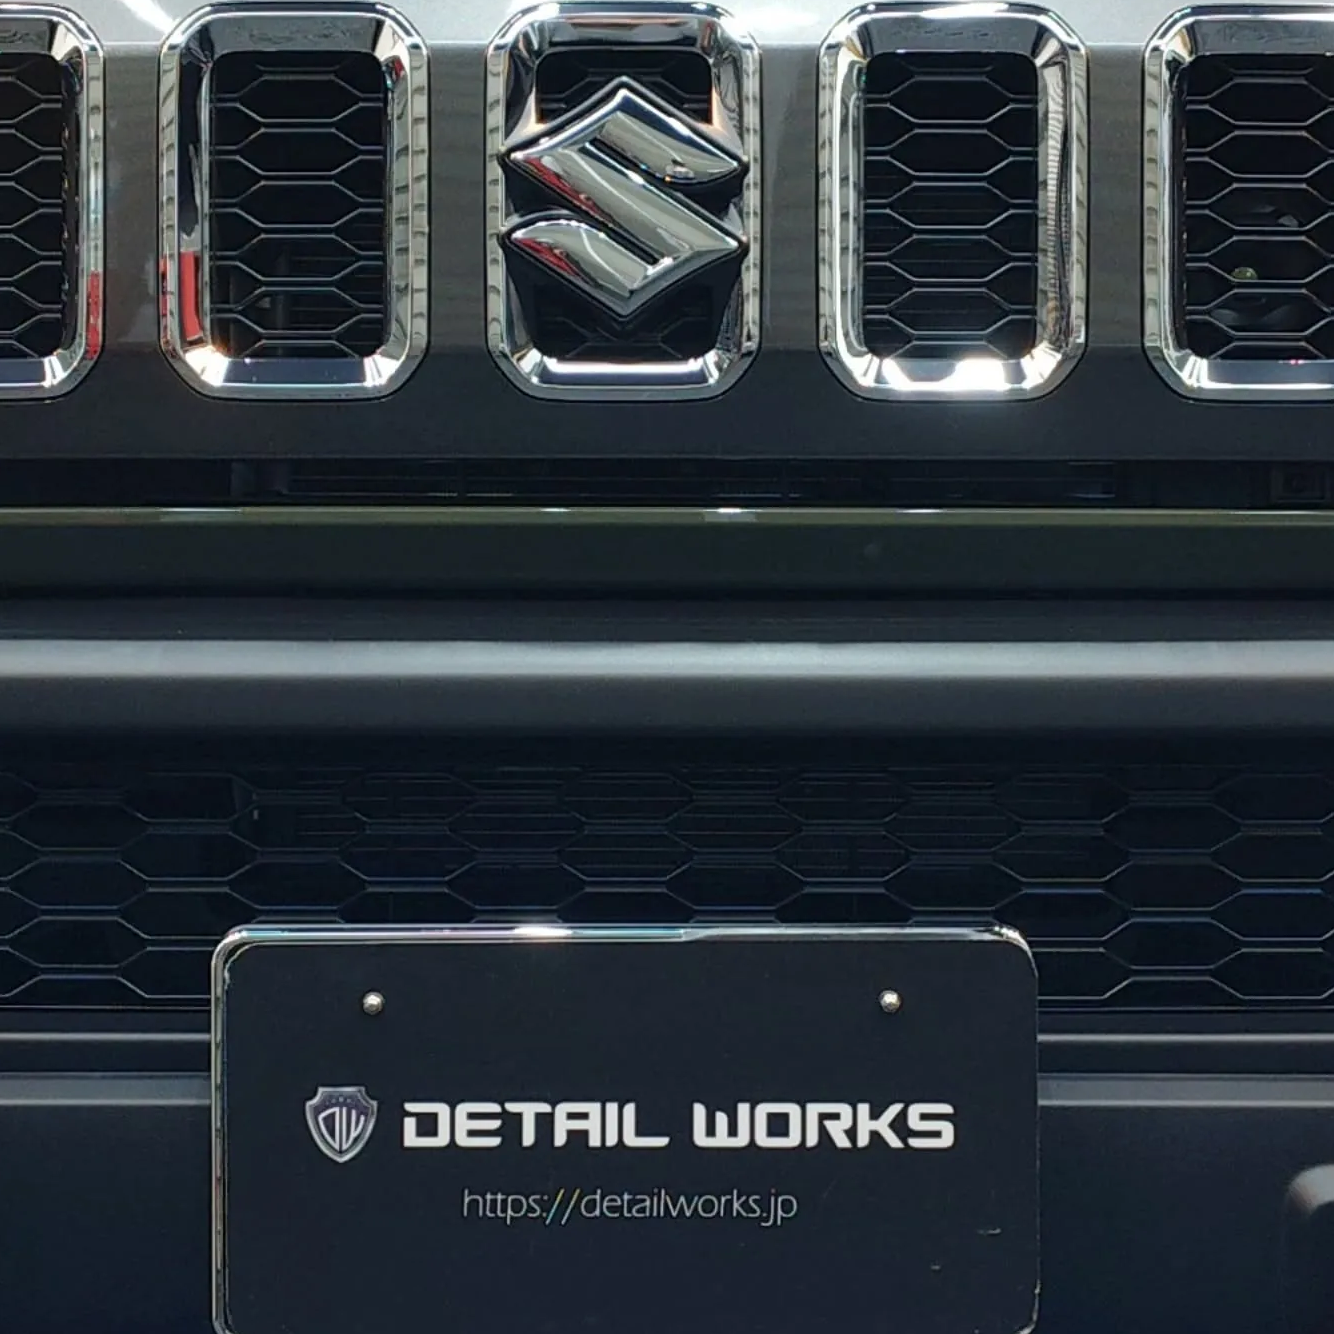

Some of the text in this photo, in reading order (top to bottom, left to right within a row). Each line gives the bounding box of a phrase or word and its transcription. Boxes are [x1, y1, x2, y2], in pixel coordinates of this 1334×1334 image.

[403, 1101, 955, 1149] DETAIL WORKS
[463, 1187, 798, 1227] https://detailworks.jp
